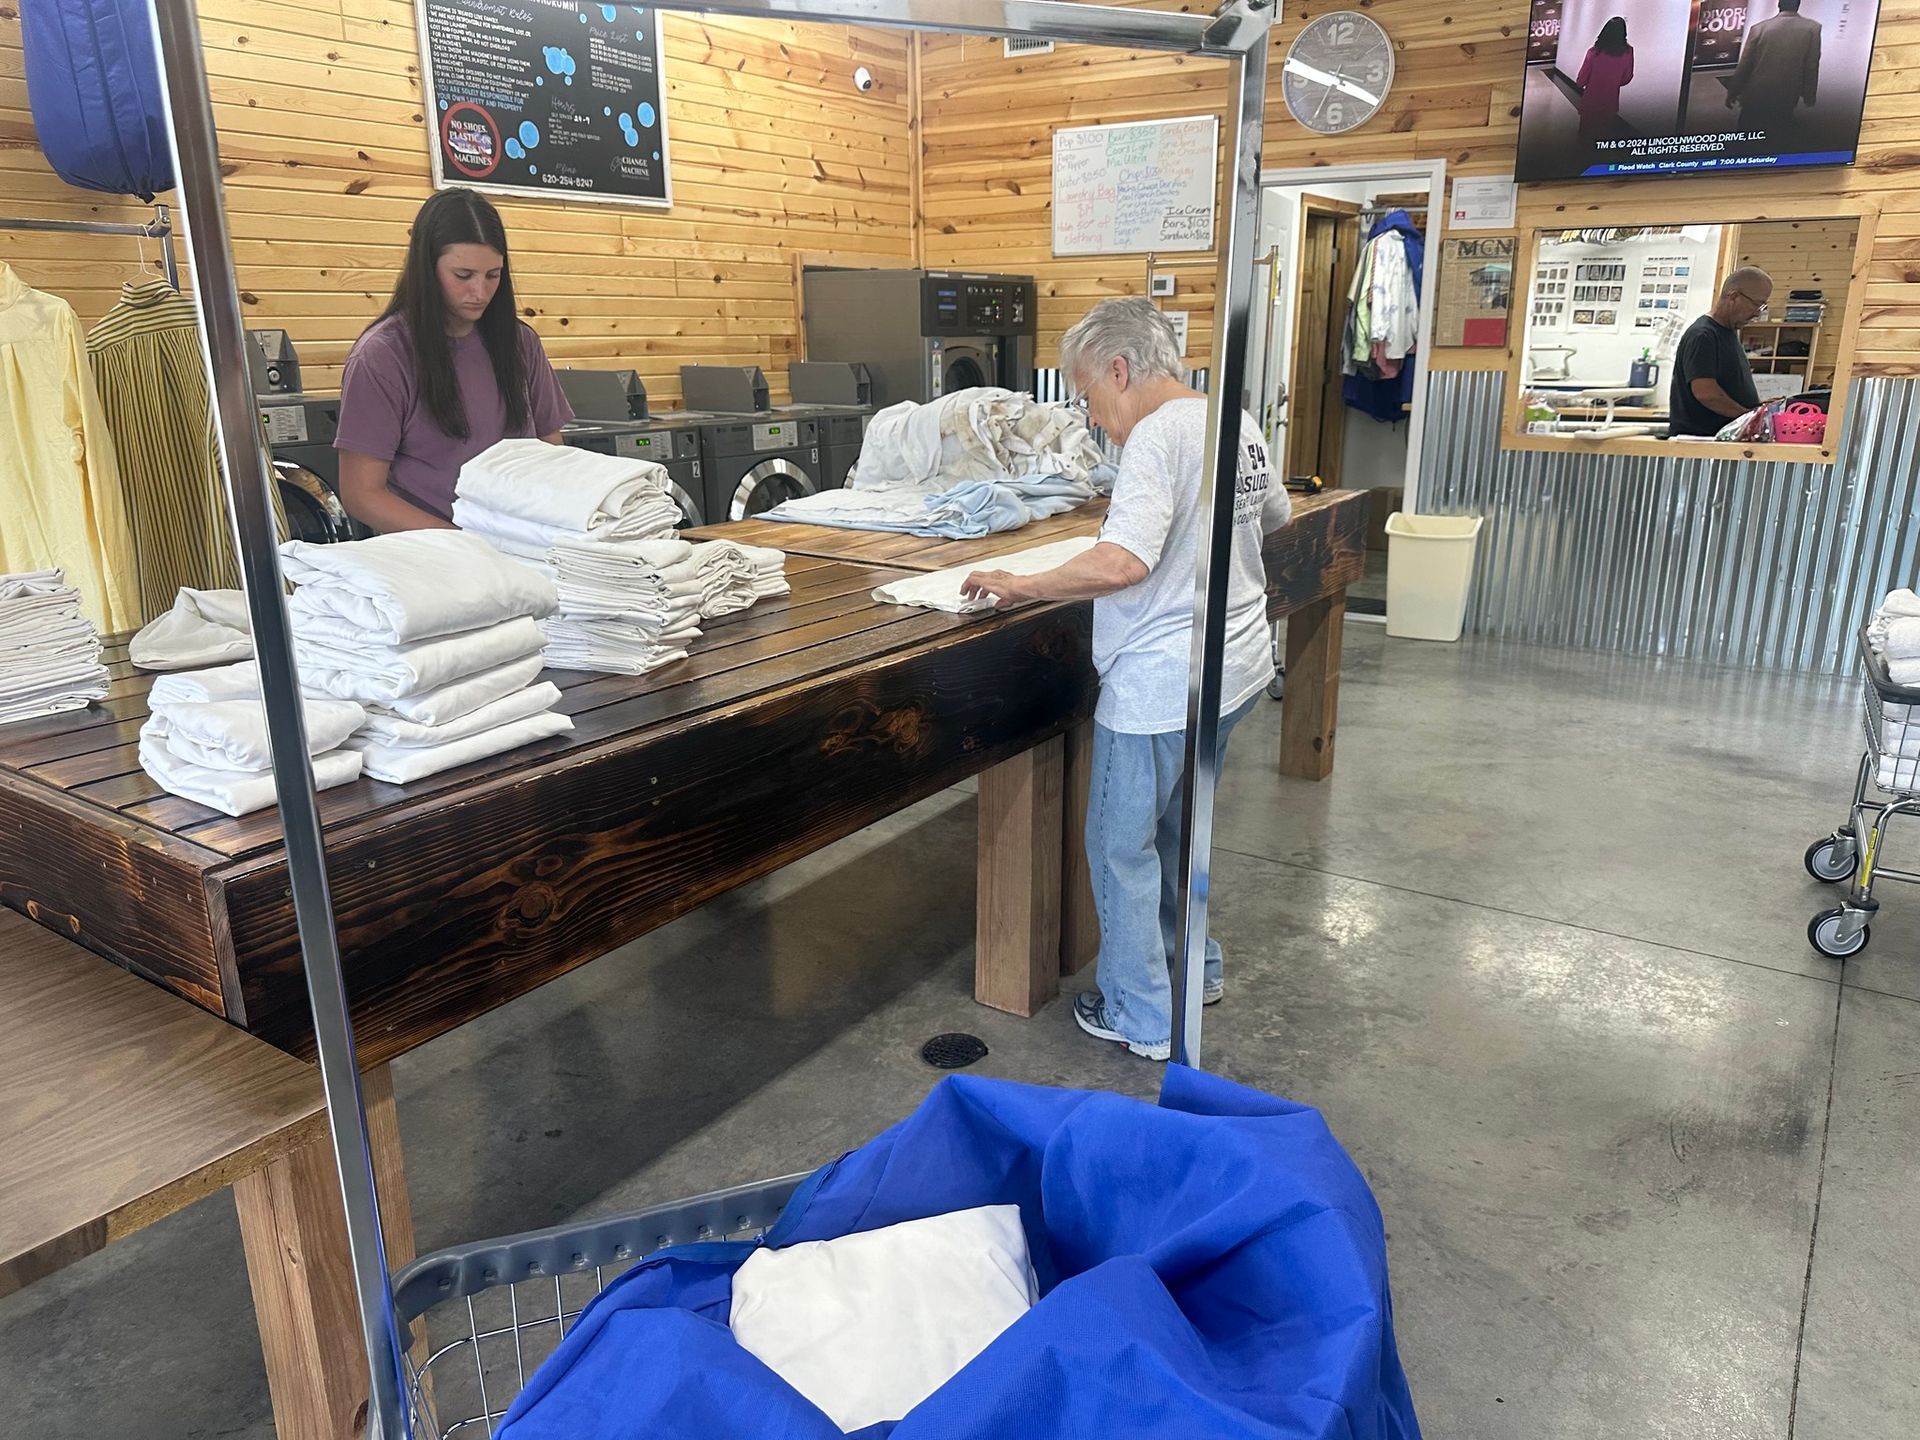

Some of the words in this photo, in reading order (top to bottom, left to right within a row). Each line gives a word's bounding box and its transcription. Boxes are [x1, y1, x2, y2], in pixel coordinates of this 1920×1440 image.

[1327, 22, 1354, 46] 12
[1366, 60, 1384, 82] 3
[438, 83, 448, 91] YOU
[449, 85, 460, 93] ARE
[437, 92, 450, 100] YOUR
[451, 94, 464, 102] OWN
[485, 100, 496, 108] AND
[1326, 102, 1343, 125] 6
[451, 120, 462, 129] NO
[449, 130, 480, 142] PLASTIC
[1627, 140, 1647, 148] 2024
[1648, 134, 1717, 146] LINCOLNWOOD
[1718, 132, 1747, 142] DRIVE,
[1748, 131, 1766, 140] LLC.
[1631, 148, 1646, 156] ALL
[1647, 146, 1678, 155] RIGHTS
[1680, 143, 1725, 153] RESERVED.
[454, 153, 492, 166] MACHINES
[622, 156, 648, 167] CHANGE
[1659, 161, 1675, 169] Clark
[1676, 160, 1698, 169] County
[1748, 156, 1778, 164] Saturday
[621, 165, 650, 177] MACHINE
[1165, 206, 1183, 216] Ice
[1184, 205, 1211, 214] Cream
[1162, 219, 1186, 229] Bars
[1160, 230, 1195, 241] Sandwich
